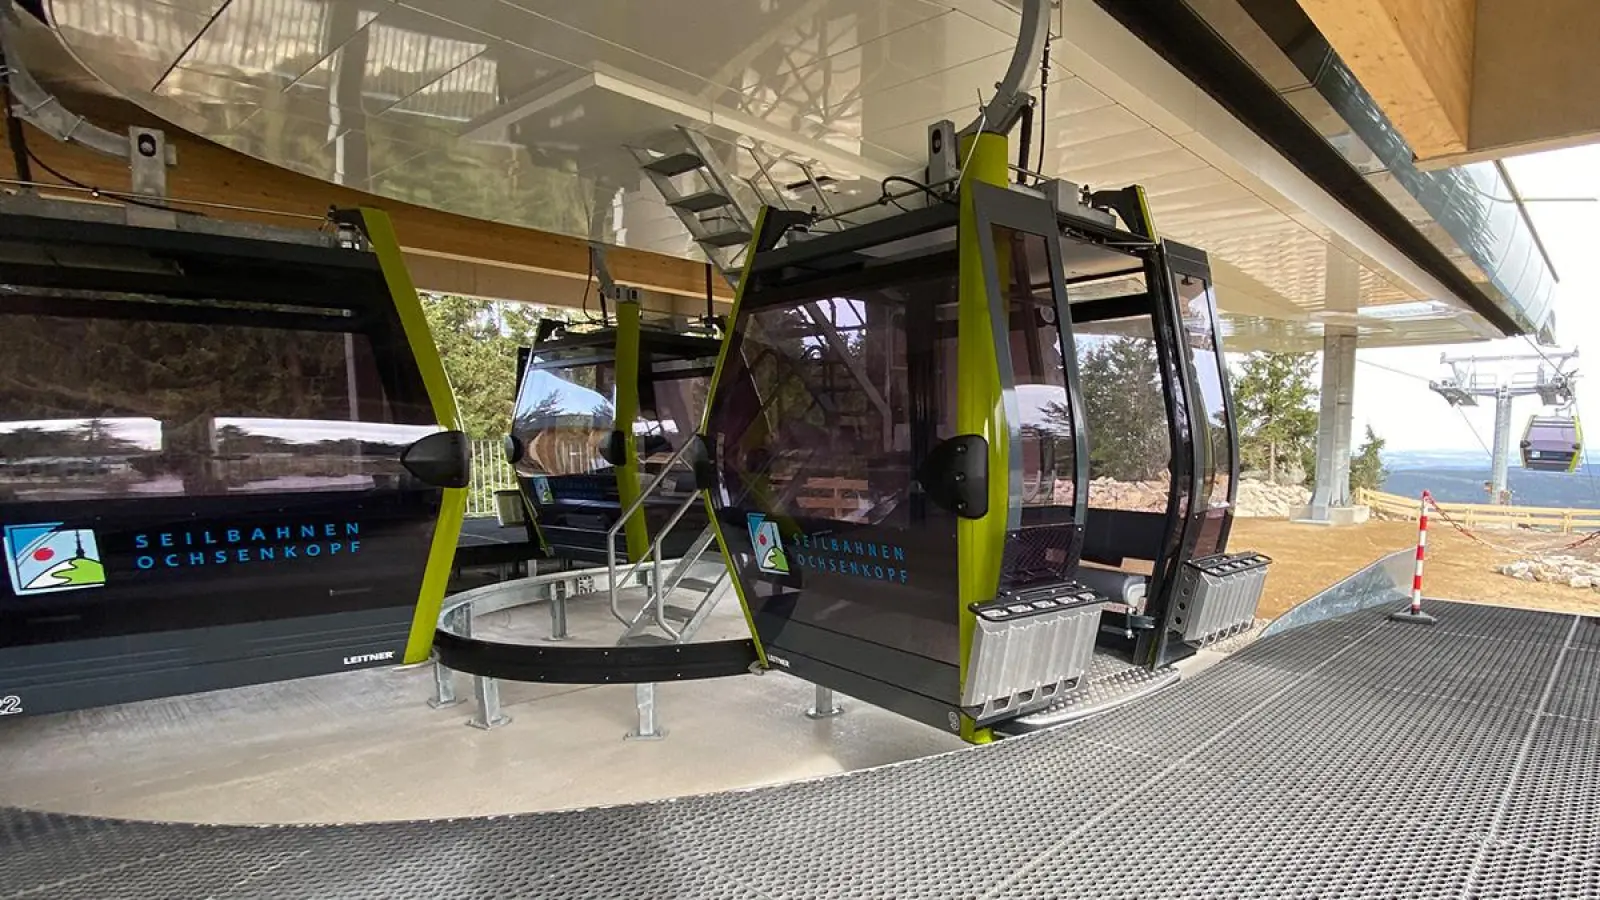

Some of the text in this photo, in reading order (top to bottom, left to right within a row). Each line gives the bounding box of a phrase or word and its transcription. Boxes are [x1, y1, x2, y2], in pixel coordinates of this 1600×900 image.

[135, 523, 359, 549] SEILBAHNEN
[792, 532, 905, 561] SEILBAHNEN
[137, 541, 361, 569] OCHSENKOPF
[797, 554, 907, 583] OCHSENKOPF
[343, 651, 394, 665] LEITNER
